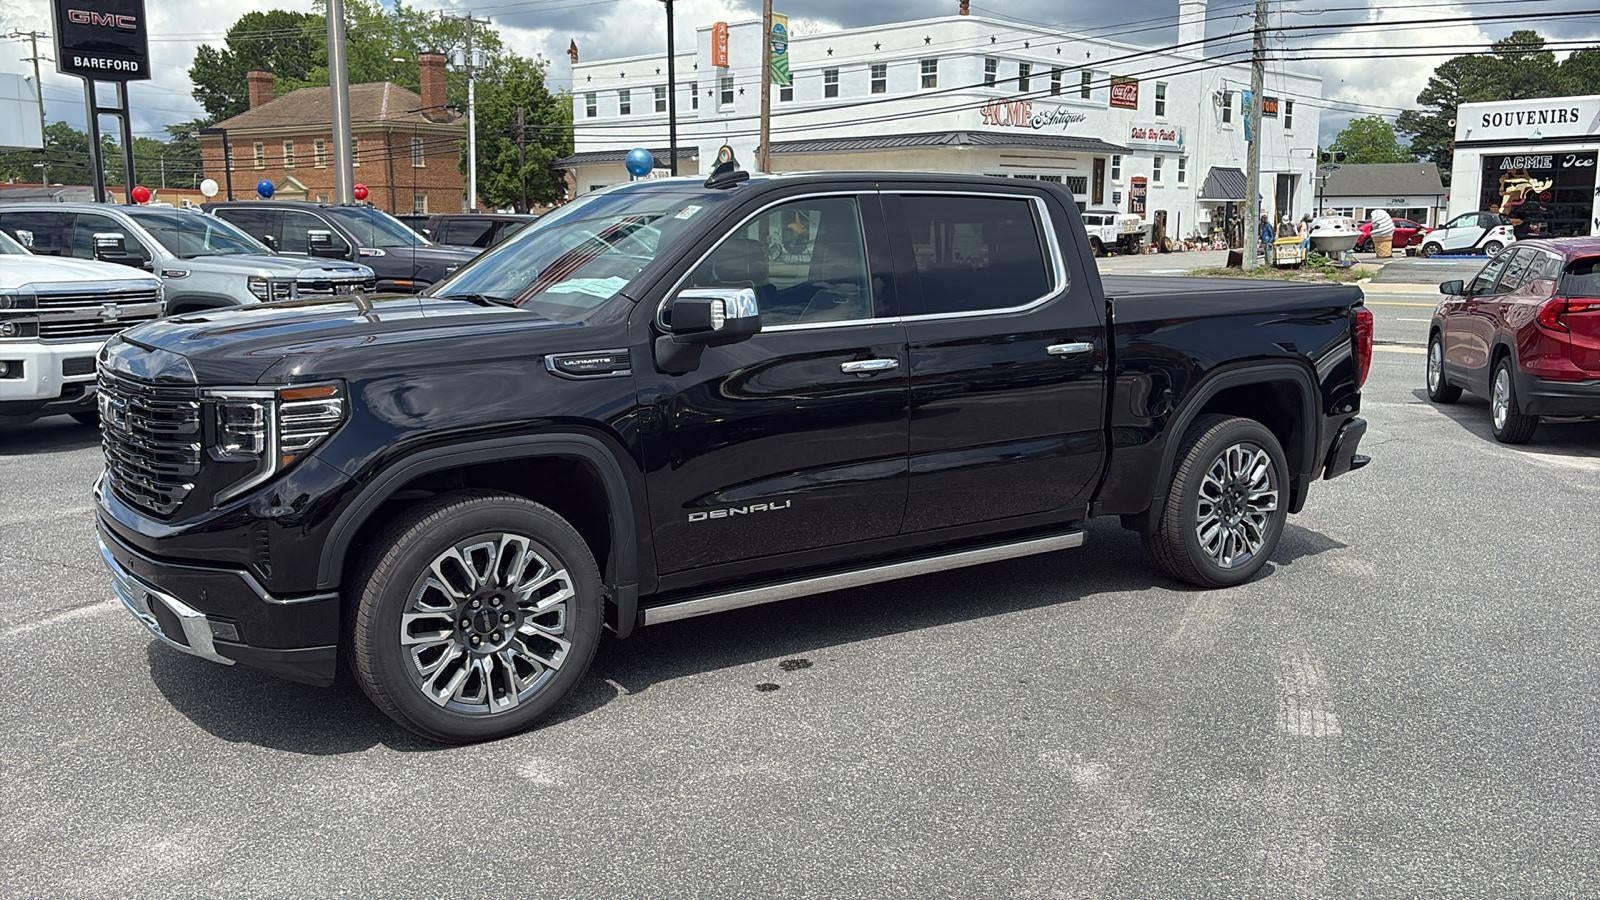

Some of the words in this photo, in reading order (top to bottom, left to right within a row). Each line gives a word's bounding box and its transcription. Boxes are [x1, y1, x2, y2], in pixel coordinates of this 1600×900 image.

[68, 9, 137, 29] GMC
[73, 56, 139, 72] BAREFORD
[980, 98, 1033, 128] ACME
[1031, 104, 1087, 131] Antiques
[1481, 107, 1580, 128] SOUVENIRS
[1500, 155, 1553, 170] ACME
[1562, 154, 1595, 168] Ice
[1133, 201, 1144, 212] TEA
[563, 358, 611, 366] ULTIMATE
[687, 499, 791, 523] DENALI
